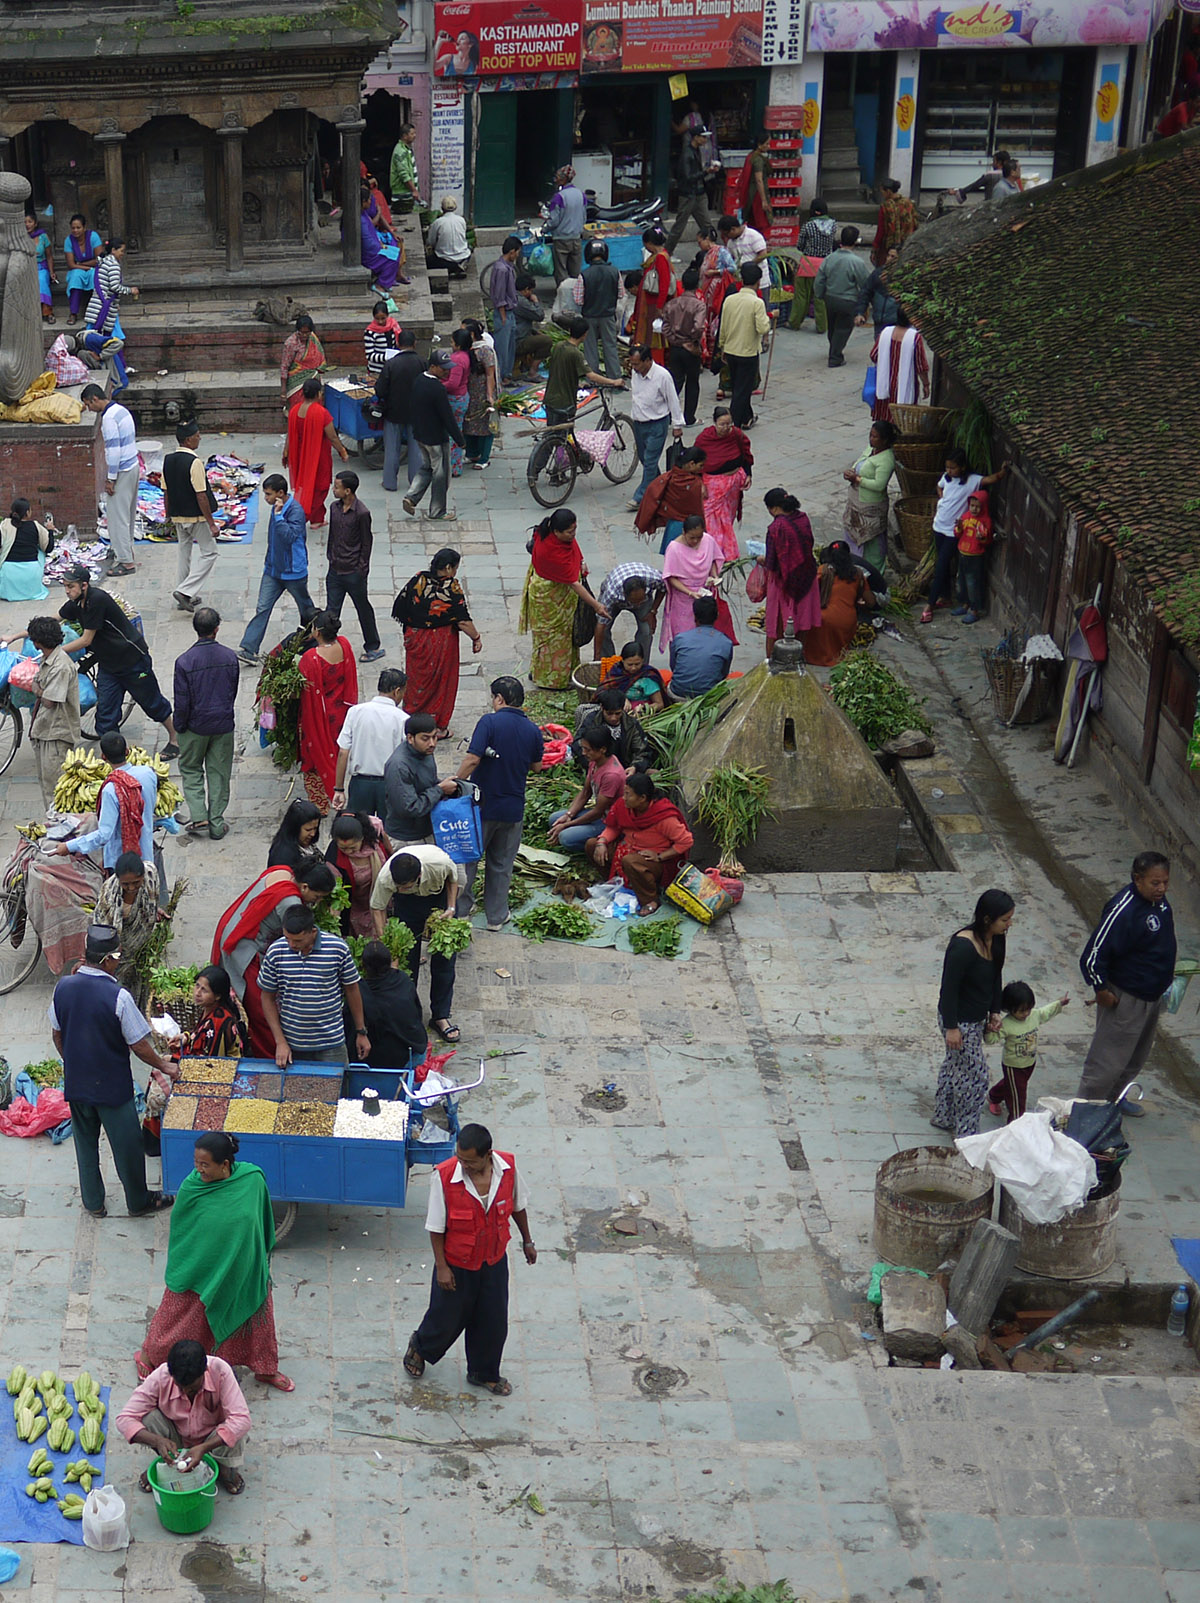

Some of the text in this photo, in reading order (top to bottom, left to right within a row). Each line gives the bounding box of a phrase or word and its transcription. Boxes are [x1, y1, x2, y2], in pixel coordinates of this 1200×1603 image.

[585, 0, 762, 20] Lumbini Buddhist Thanka Painting School
[942, 1, 1015, 27] nd's
[479, 22, 579, 41] KASTHAMANDAP
[955, 26, 1003, 35] ICE CREAM
[494, 40, 565, 55] RESTAURANT
[651, 40, 733, 53] Himalayan
[788, 24, 800, 60] STORE
[482, 52, 577, 69] ROOF TOP VIEW
[439, 819, 469, 832] Cute
